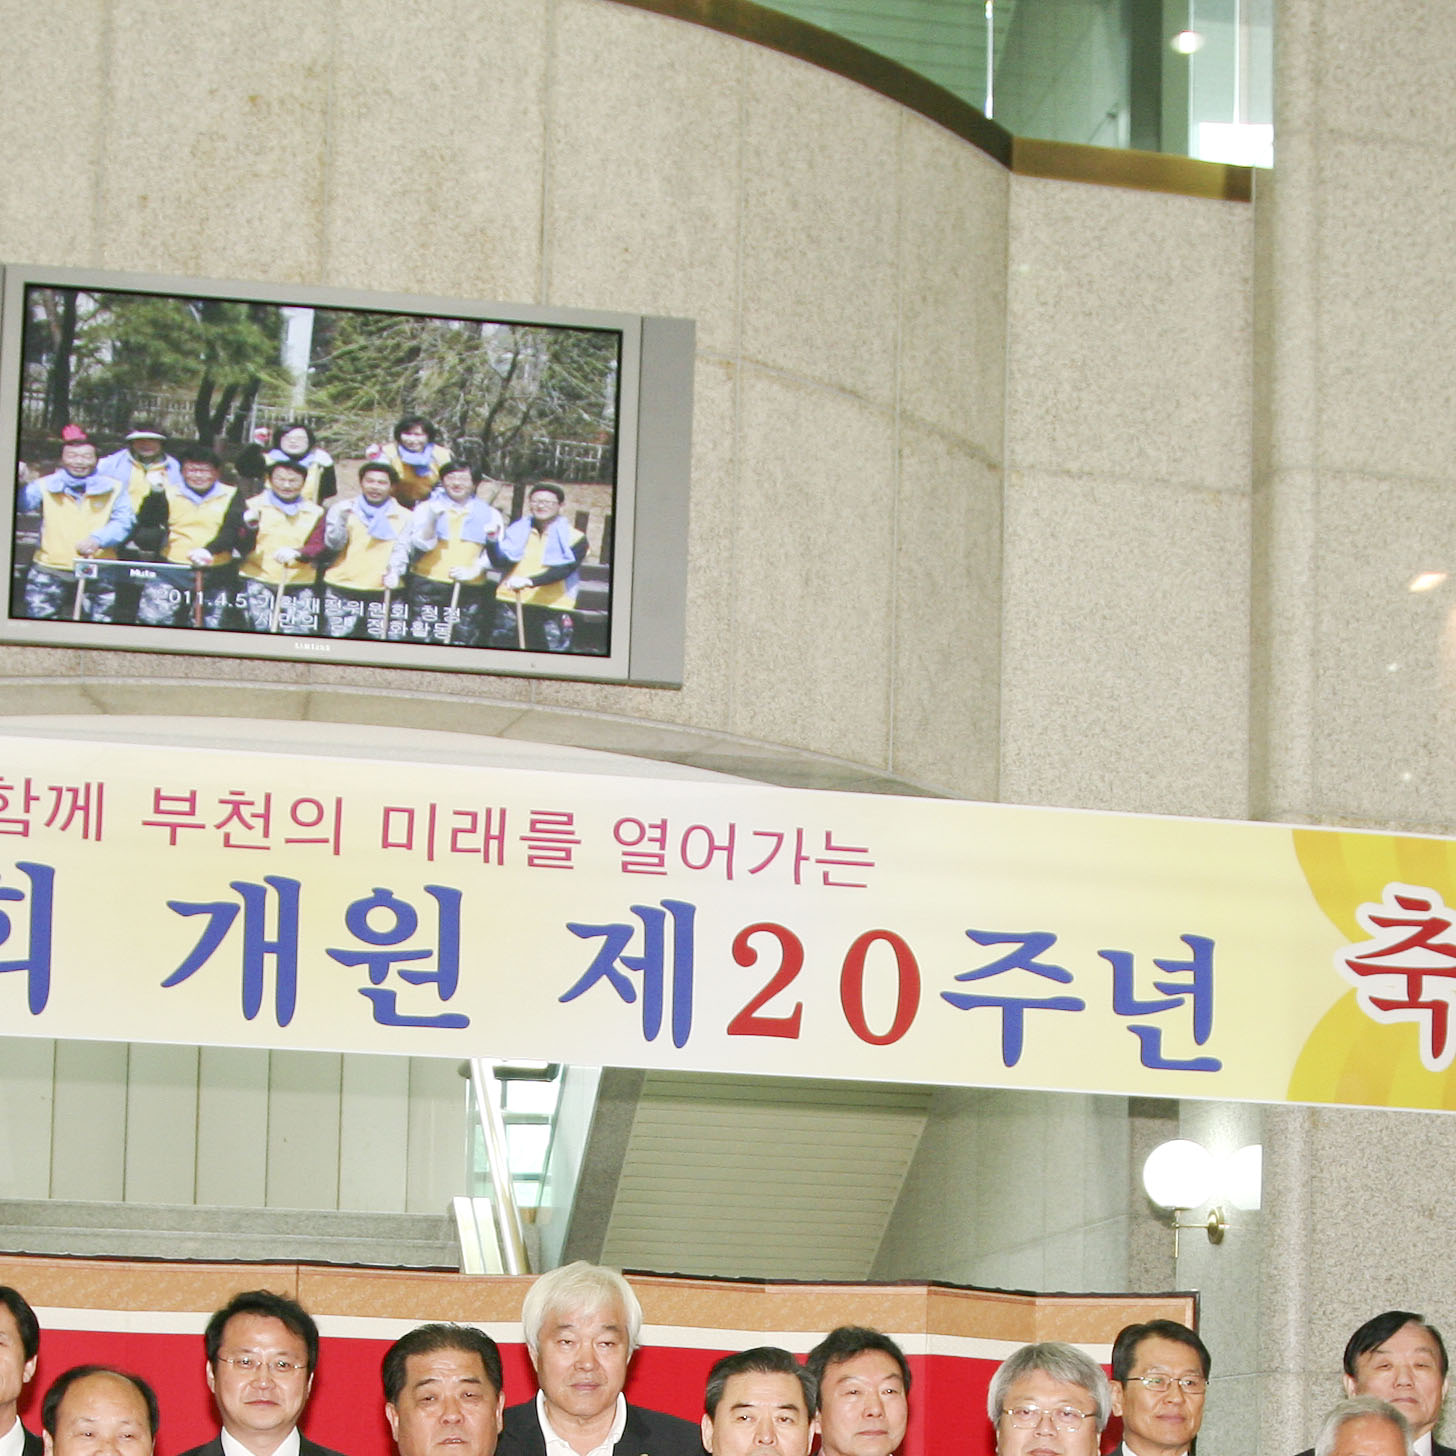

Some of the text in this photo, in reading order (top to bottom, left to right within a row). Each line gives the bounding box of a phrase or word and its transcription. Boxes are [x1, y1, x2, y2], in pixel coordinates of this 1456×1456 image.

[142, 786, 344, 857] 부천의
[380, 804, 582, 869] 미래를
[611, 815, 876, 888] 열어가는
[160, 876, 470, 1029] 개원
[559, 898, 1222, 1073] 제20주년
